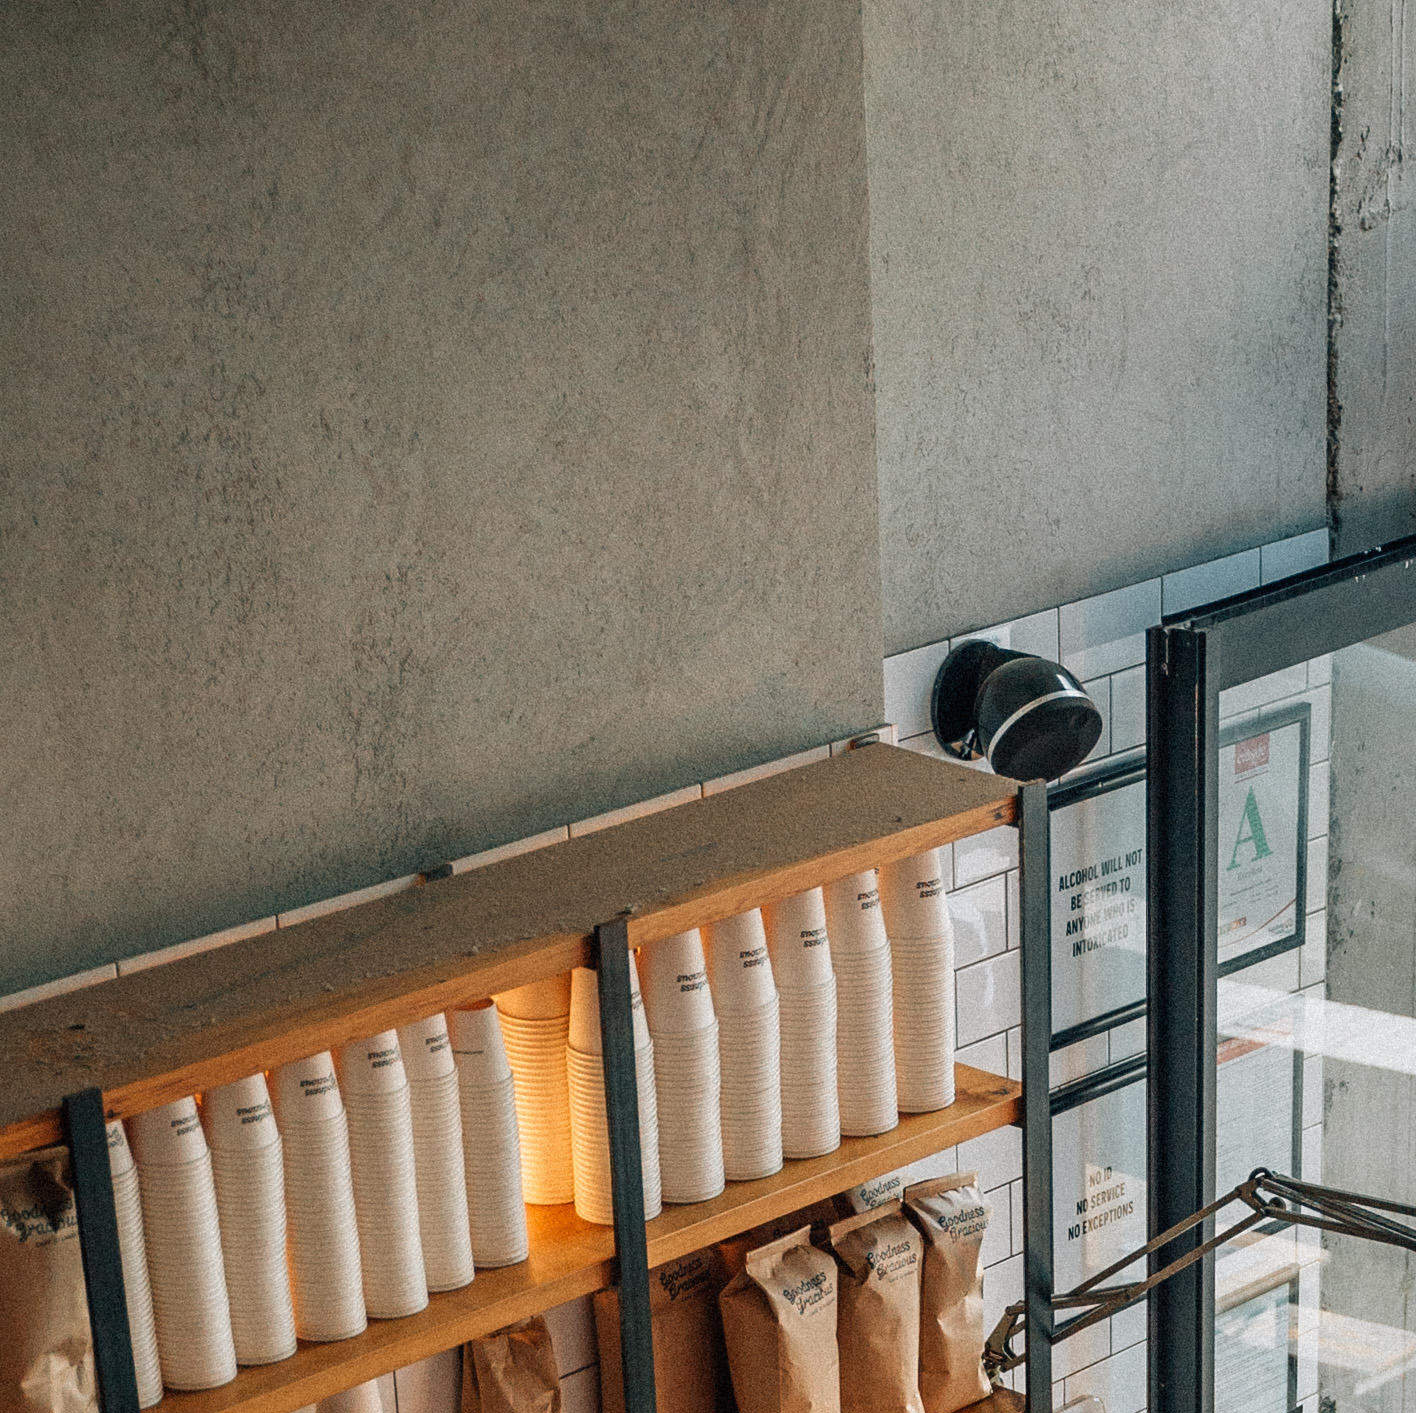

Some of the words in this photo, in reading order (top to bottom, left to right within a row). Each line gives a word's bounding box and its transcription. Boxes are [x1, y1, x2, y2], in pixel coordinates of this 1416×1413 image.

[1226, 785, 1274, 871] A
[1059, 864, 1098, 892] ALCOHOL
[1101, 856, 1123, 877] WILL
[1125, 848, 1143, 868] NOT
[1070, 893, 1082, 911] BE
[1084, 881, 1118, 906] SERVED
[1120, 876, 1131, 893] TO
[1065, 910, 1101, 937] ANYONE
[1103, 902, 1125, 922] WHO
[1127, 897, 1136, 913] IS
[1072, 924, 1129, 957] INTOXICATED
[1089, 1170, 1102, 1188] NO
[1104, 1166, 1113, 1182] ID
[1076, 1198, 1088, 1216] NO
[1090, 1182, 1126, 1209] SERVICE
[937, 1206, 985, 1232] Goodness
[1068, 1223, 1080, 1241] NO
[1082, 1200, 1134, 1235] EXCEPTIONS
[866, 1241, 910, 1270] Goodness
[877, 1253, 917, 1281] Gracious
[782, 1271, 827, 1305] Goodness
